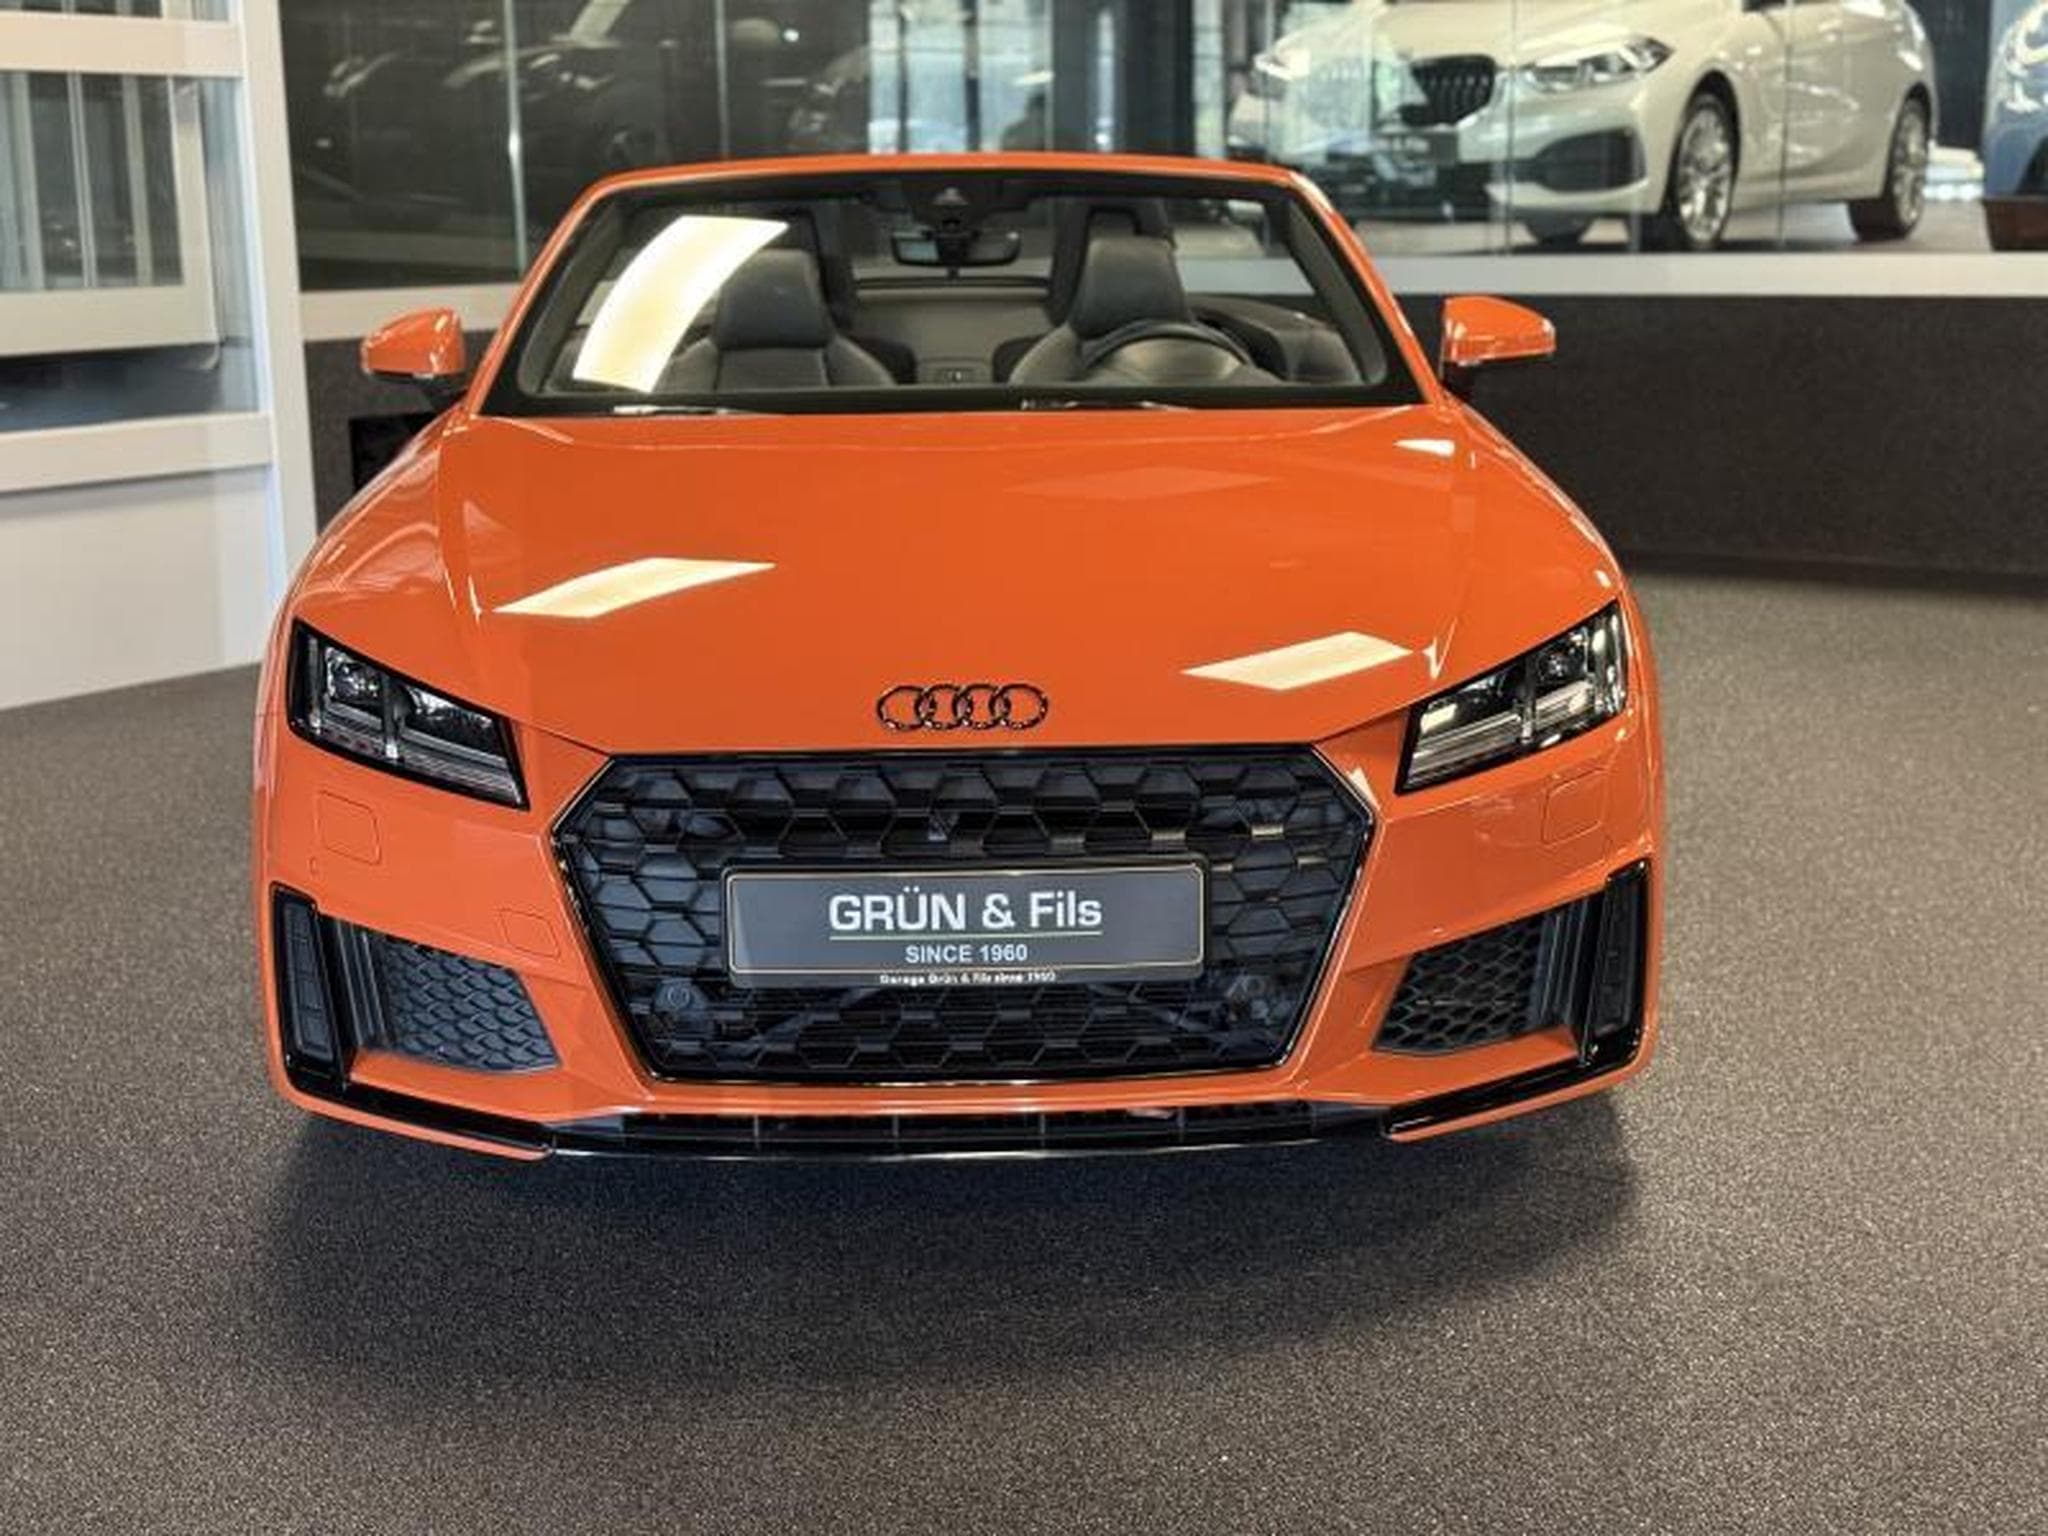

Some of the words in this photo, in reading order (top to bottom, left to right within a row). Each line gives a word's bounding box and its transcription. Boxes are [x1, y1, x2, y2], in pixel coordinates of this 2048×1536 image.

[829, 886, 965, 931] GRÜN
[982, 893, 1015, 929] &
[1030, 890, 1102, 928] Fils
[905, 945, 973, 964] SINCE
[980, 943, 1028, 962] 1960
[879, 974, 926, 988] Garage
